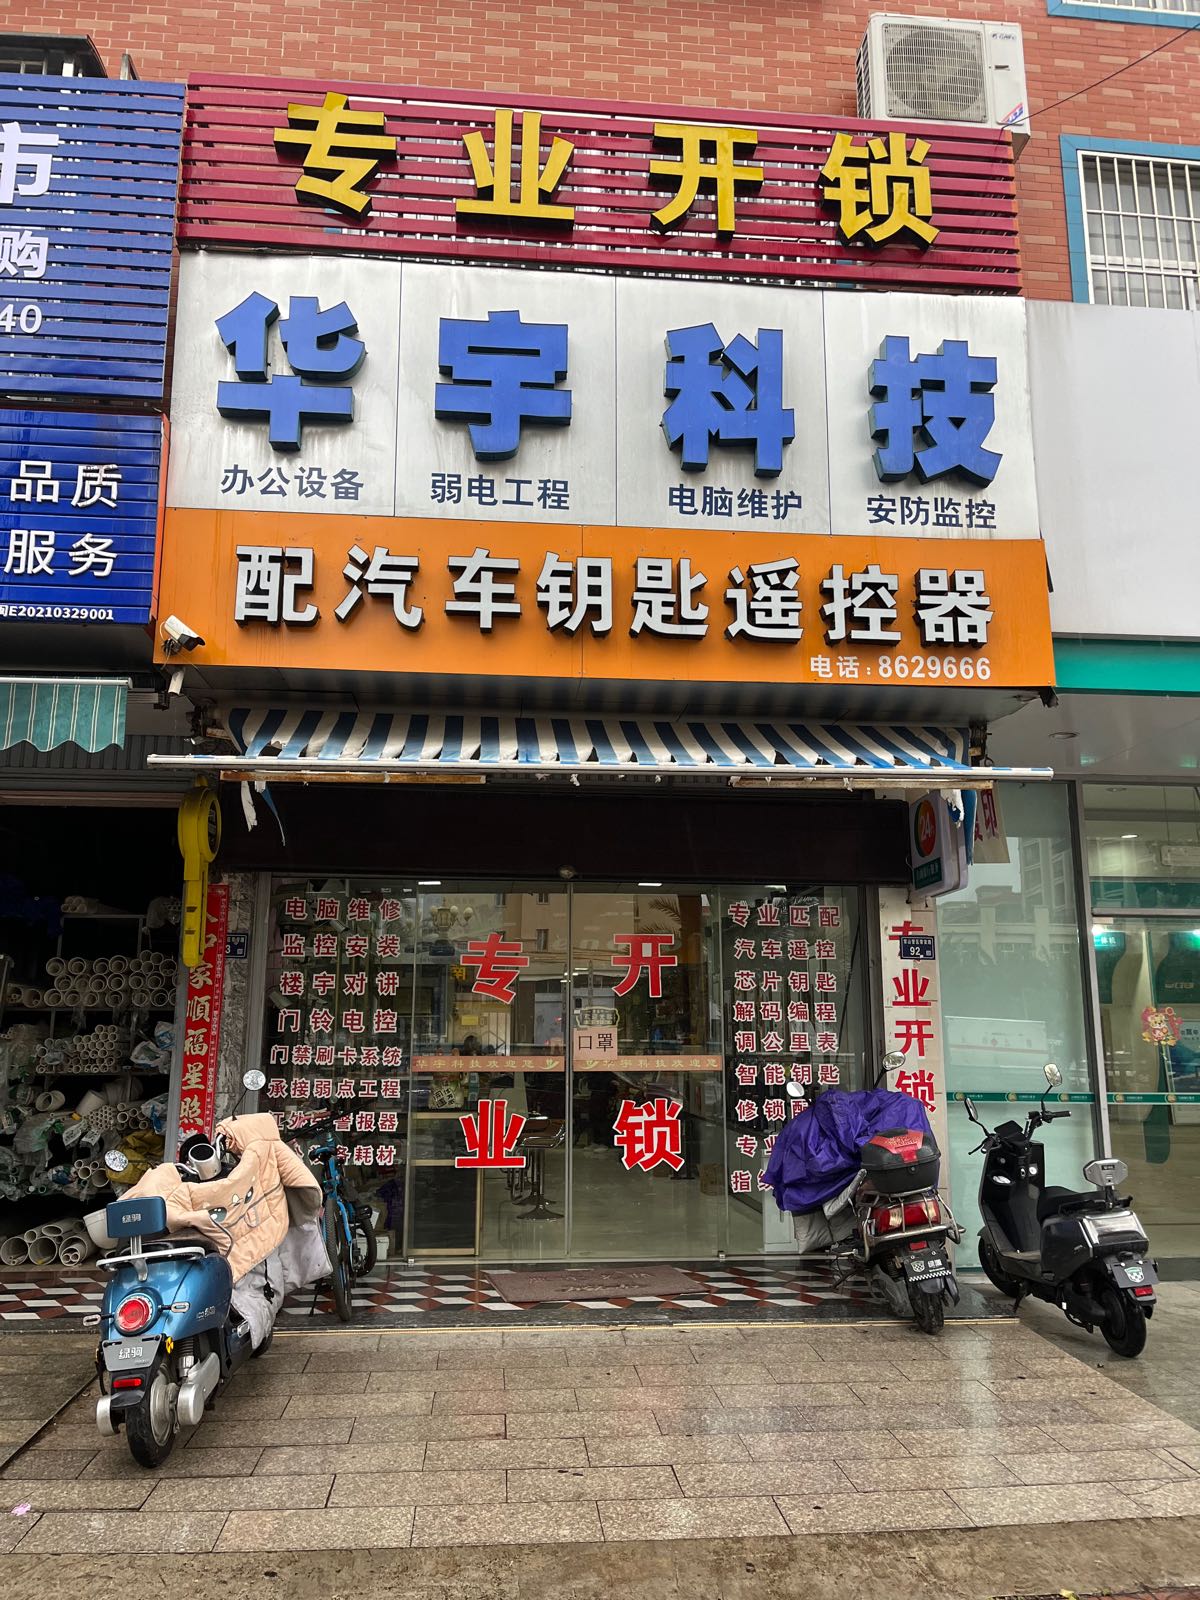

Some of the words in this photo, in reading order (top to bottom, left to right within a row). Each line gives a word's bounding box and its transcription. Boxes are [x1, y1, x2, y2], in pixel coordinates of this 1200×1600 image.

[273, 91, 941, 246] 专业开锁
[216, 291, 1003, 488] 华宇科技
[10, 459, 122, 508] 品质
[219, 463, 364, 502] 办公设备
[430, 472, 571, 511] 弱电工程
[668, 484, 802, 521] 电脑维护
[866, 494, 997, 530] 安防监控
[3, 529, 118, 578] 服务
[234, 544, 995, 647] 配汽车钥匙遥控器
[285, 898, 401, 921] 电脑维修
[727, 901, 841, 928] 专业匹配
[282, 933, 401, 958] 监控安装
[733, 938, 837, 961] 汽车遥控
[909, 946, 921, 956] 92
[280, 971, 400, 996] 楼宇对讲
[733, 970, 838, 992] 芯片钥匙
[277, 1008, 398, 1033] 门铃电控
[733, 1001, 837, 1023] 解码编程
[578, 1033, 614, 1052] 口罩
[734, 1031, 839, 1053] 调公里表
[269, 1044, 402, 1067] 门禁刷卡系统
[735, 1062, 840, 1086] 智能钥匙
[267, 1078, 401, 1099] 承接弱点工程
